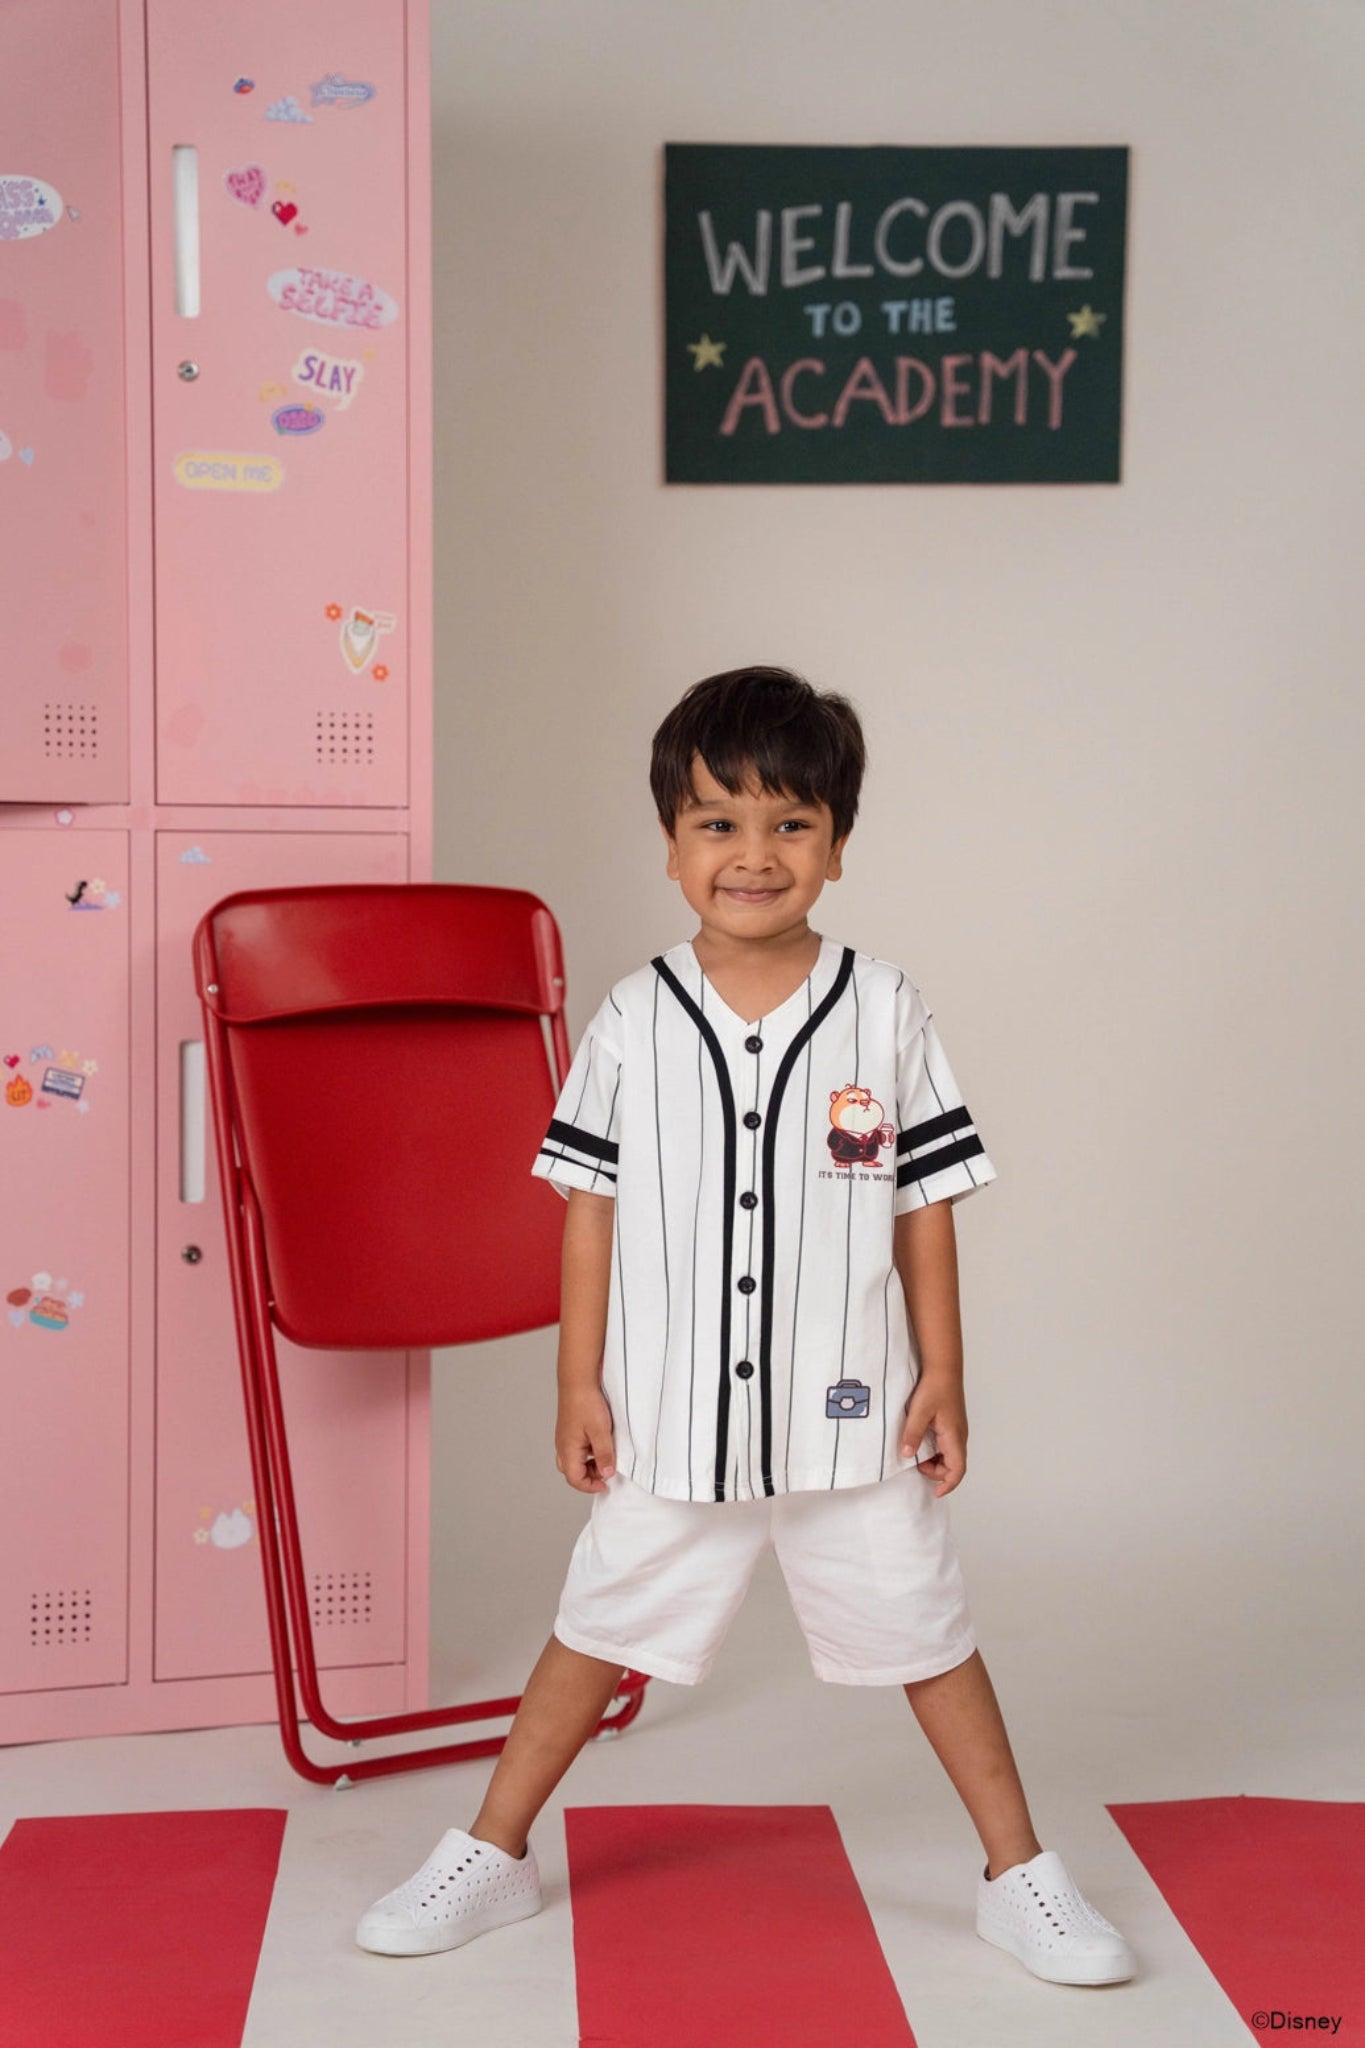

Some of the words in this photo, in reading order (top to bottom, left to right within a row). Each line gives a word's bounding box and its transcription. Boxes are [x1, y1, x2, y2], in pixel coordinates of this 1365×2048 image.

[699, 192, 1099, 296] WELCOME
[297, 267, 353, 296] TAKE
[357, 283, 374, 302] A
[280, 283, 384, 329] SELFIE
[804, 301, 862, 337] TO
[881, 297, 957, 334] THE
[298, 355, 356, 394] SLAY
[720, 347, 1077, 436] ACADEMY
[184, 461, 238, 480] OPEN
[835, 1171, 856, 1180] TIME
[858, 1172, 870, 1181] TO
[872, 1173, 894, 1182] WOR
